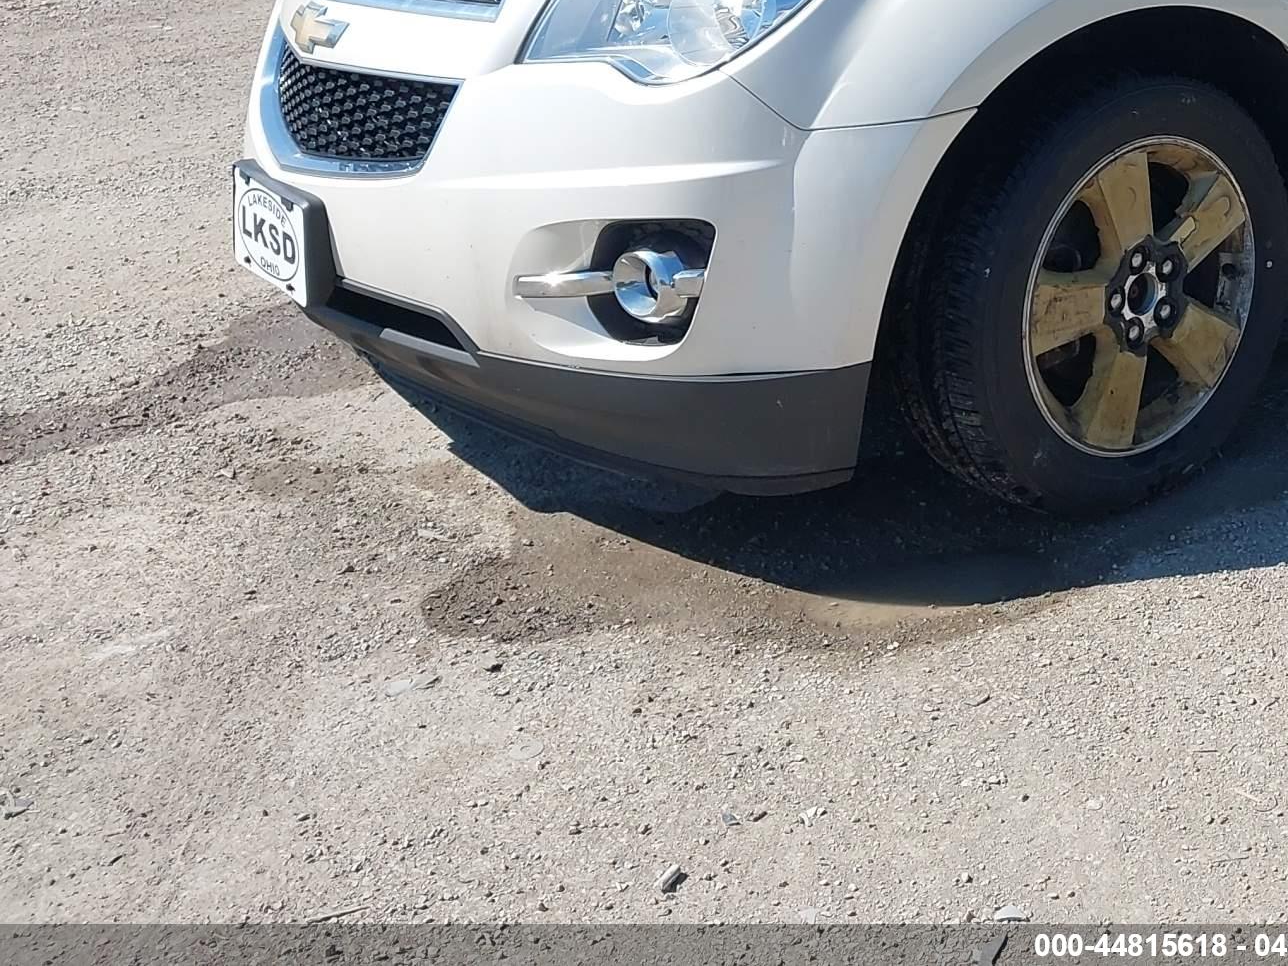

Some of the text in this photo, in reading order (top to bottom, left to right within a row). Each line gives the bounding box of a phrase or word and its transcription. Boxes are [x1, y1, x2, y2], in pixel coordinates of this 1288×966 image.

[247, 194, 286, 228] LAKESIDE
[242, 205, 296, 265] LKSD
[260, 256, 280, 276] OHIO
